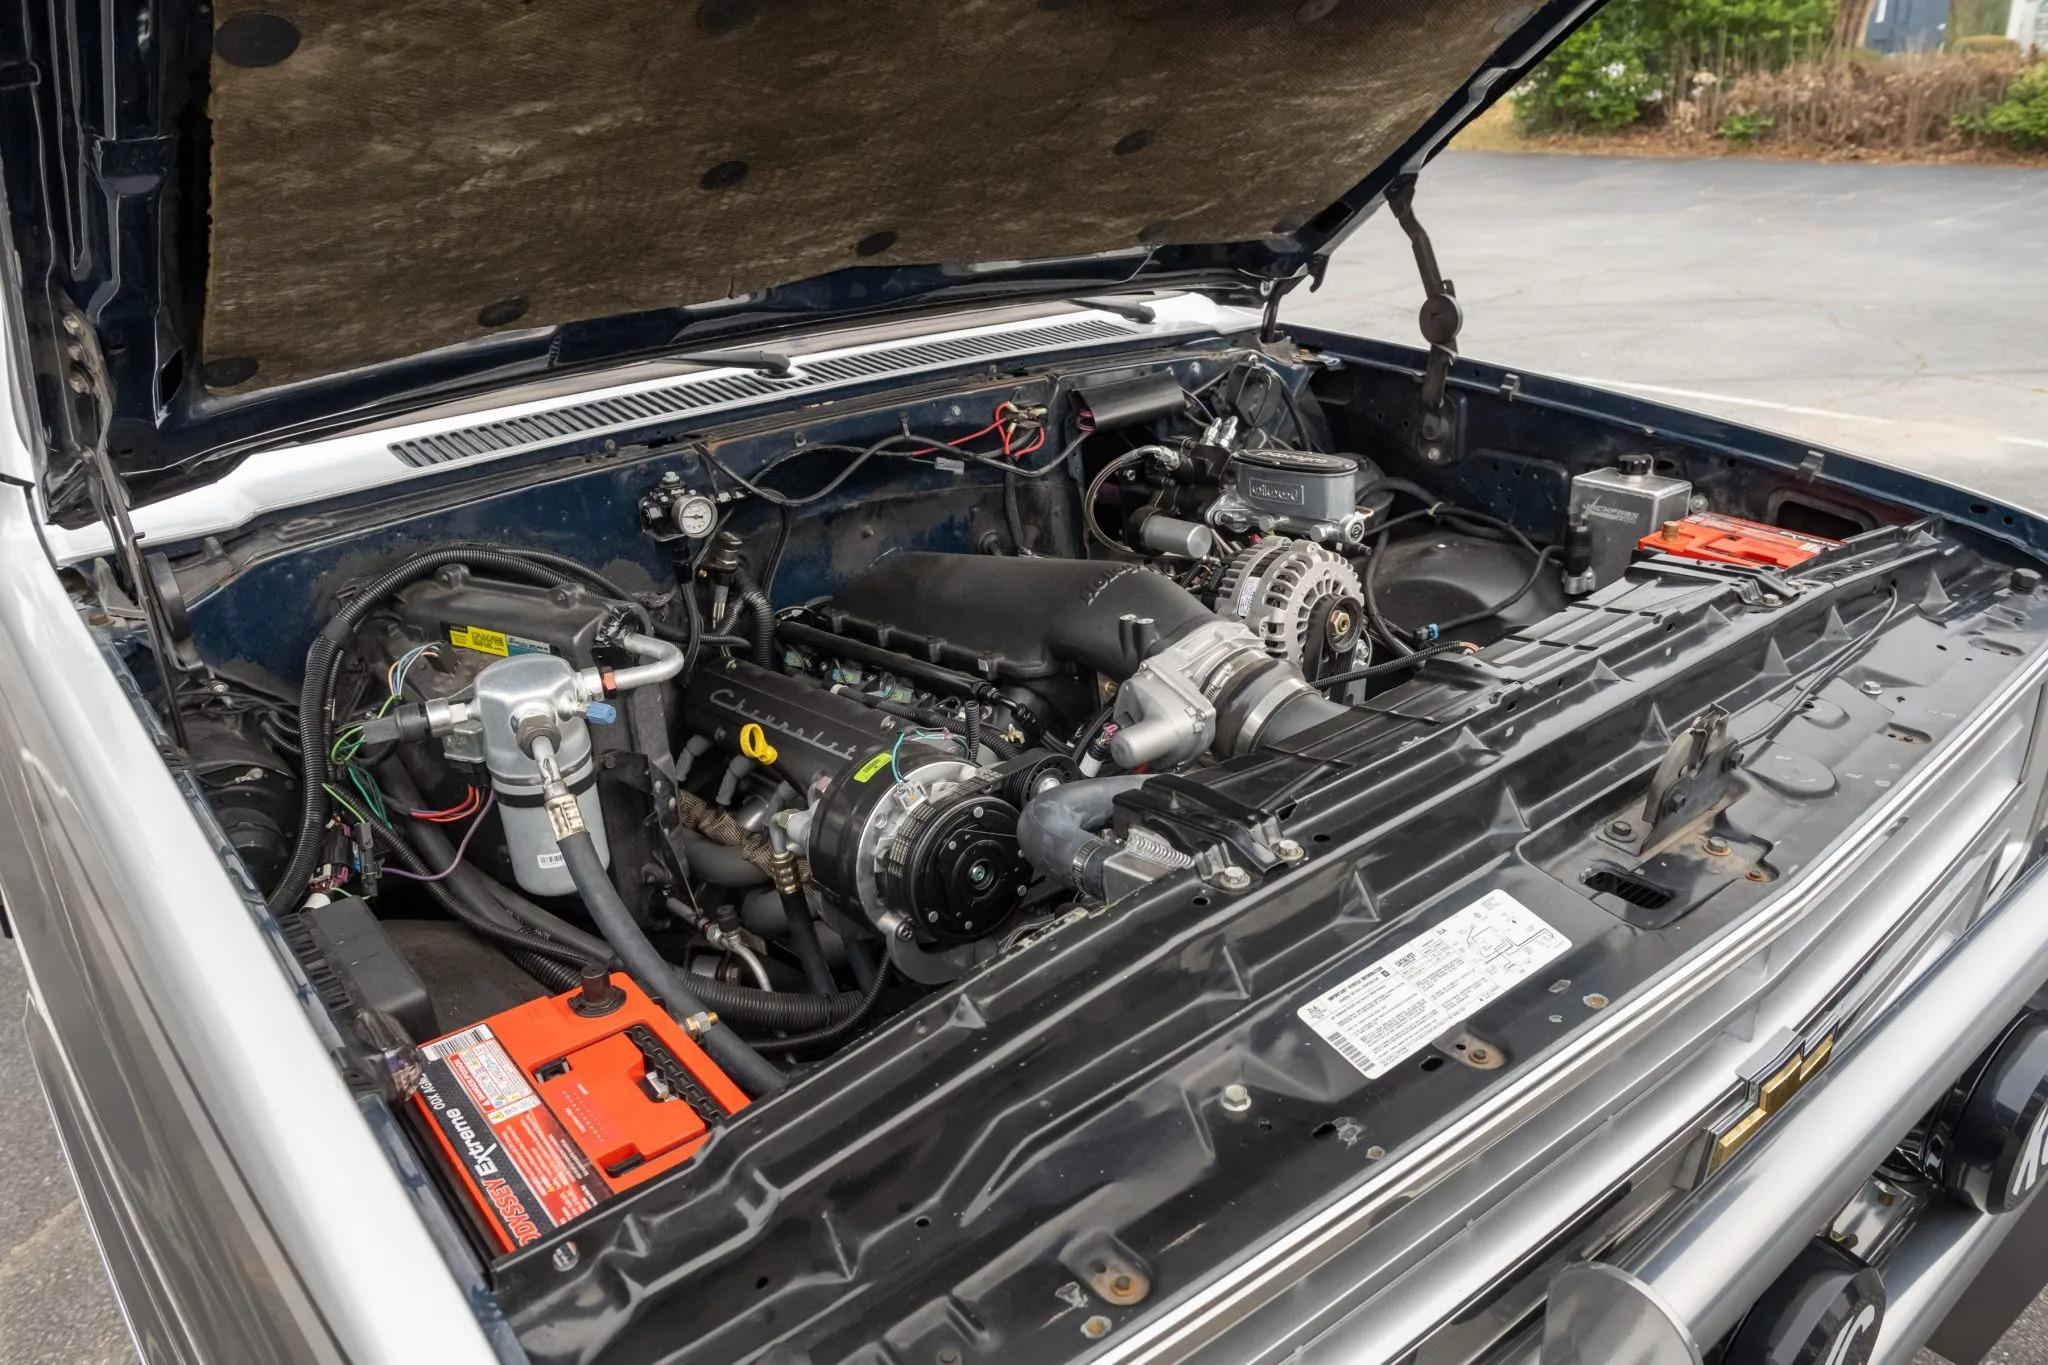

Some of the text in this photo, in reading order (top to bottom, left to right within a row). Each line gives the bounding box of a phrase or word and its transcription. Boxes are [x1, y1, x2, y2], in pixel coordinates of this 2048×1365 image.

[710, 689, 857, 761] Chevrolet
[427, 1091, 446, 1110] ODX
[446, 1107, 498, 1177] Extreme
